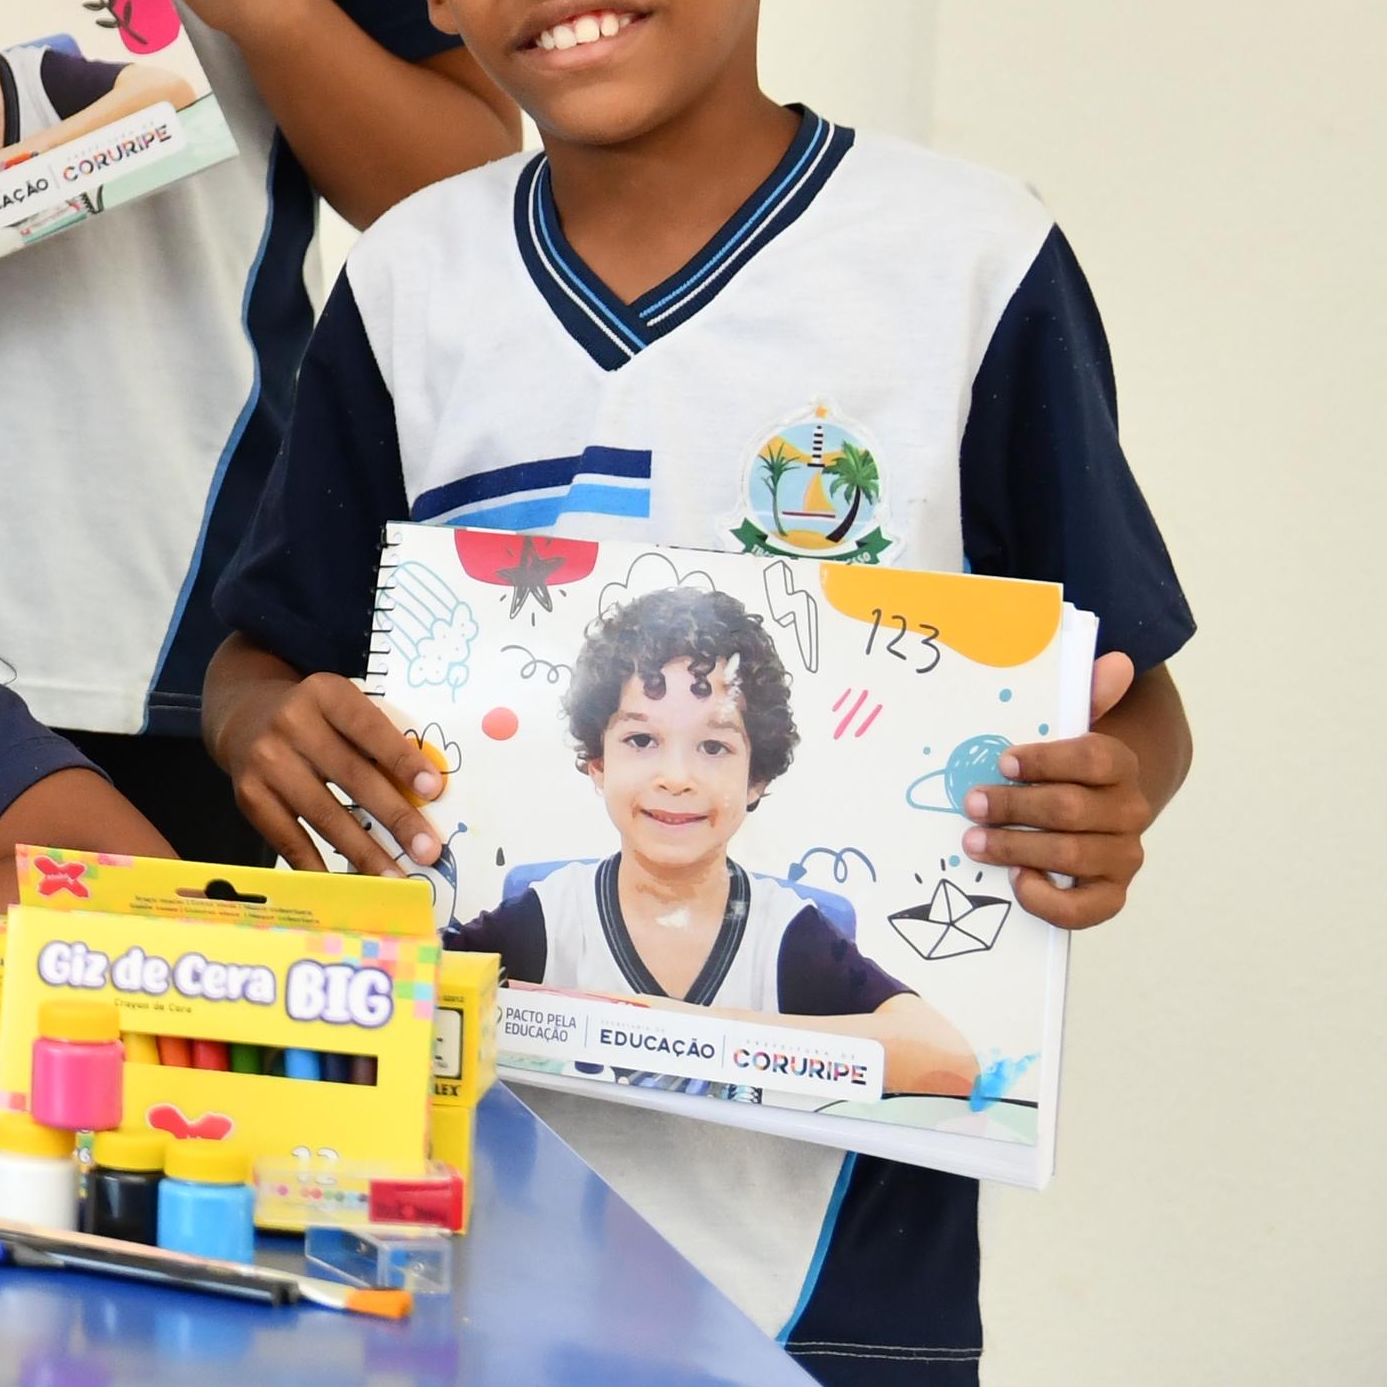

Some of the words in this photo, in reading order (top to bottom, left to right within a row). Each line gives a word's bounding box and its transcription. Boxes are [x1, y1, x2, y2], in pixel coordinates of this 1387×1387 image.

[63, 123, 173, 183] CORURIPE
[865, 607, 941, 674] 123
[37, 940, 110, 989] Giz
[111, 945, 171, 996] de
[172, 951, 277, 1006] Cera
[285, 958, 395, 1030] BIG
[504, 1021, 569, 1044] EDUCAÇÃO
[505, 1006, 544, 1027] PACTO
[546, 1012, 578, 1029] PELA
[599, 1028, 716, 1060] EDUCAÇÃO
[733, 1047, 868, 1086] CORURIPE
